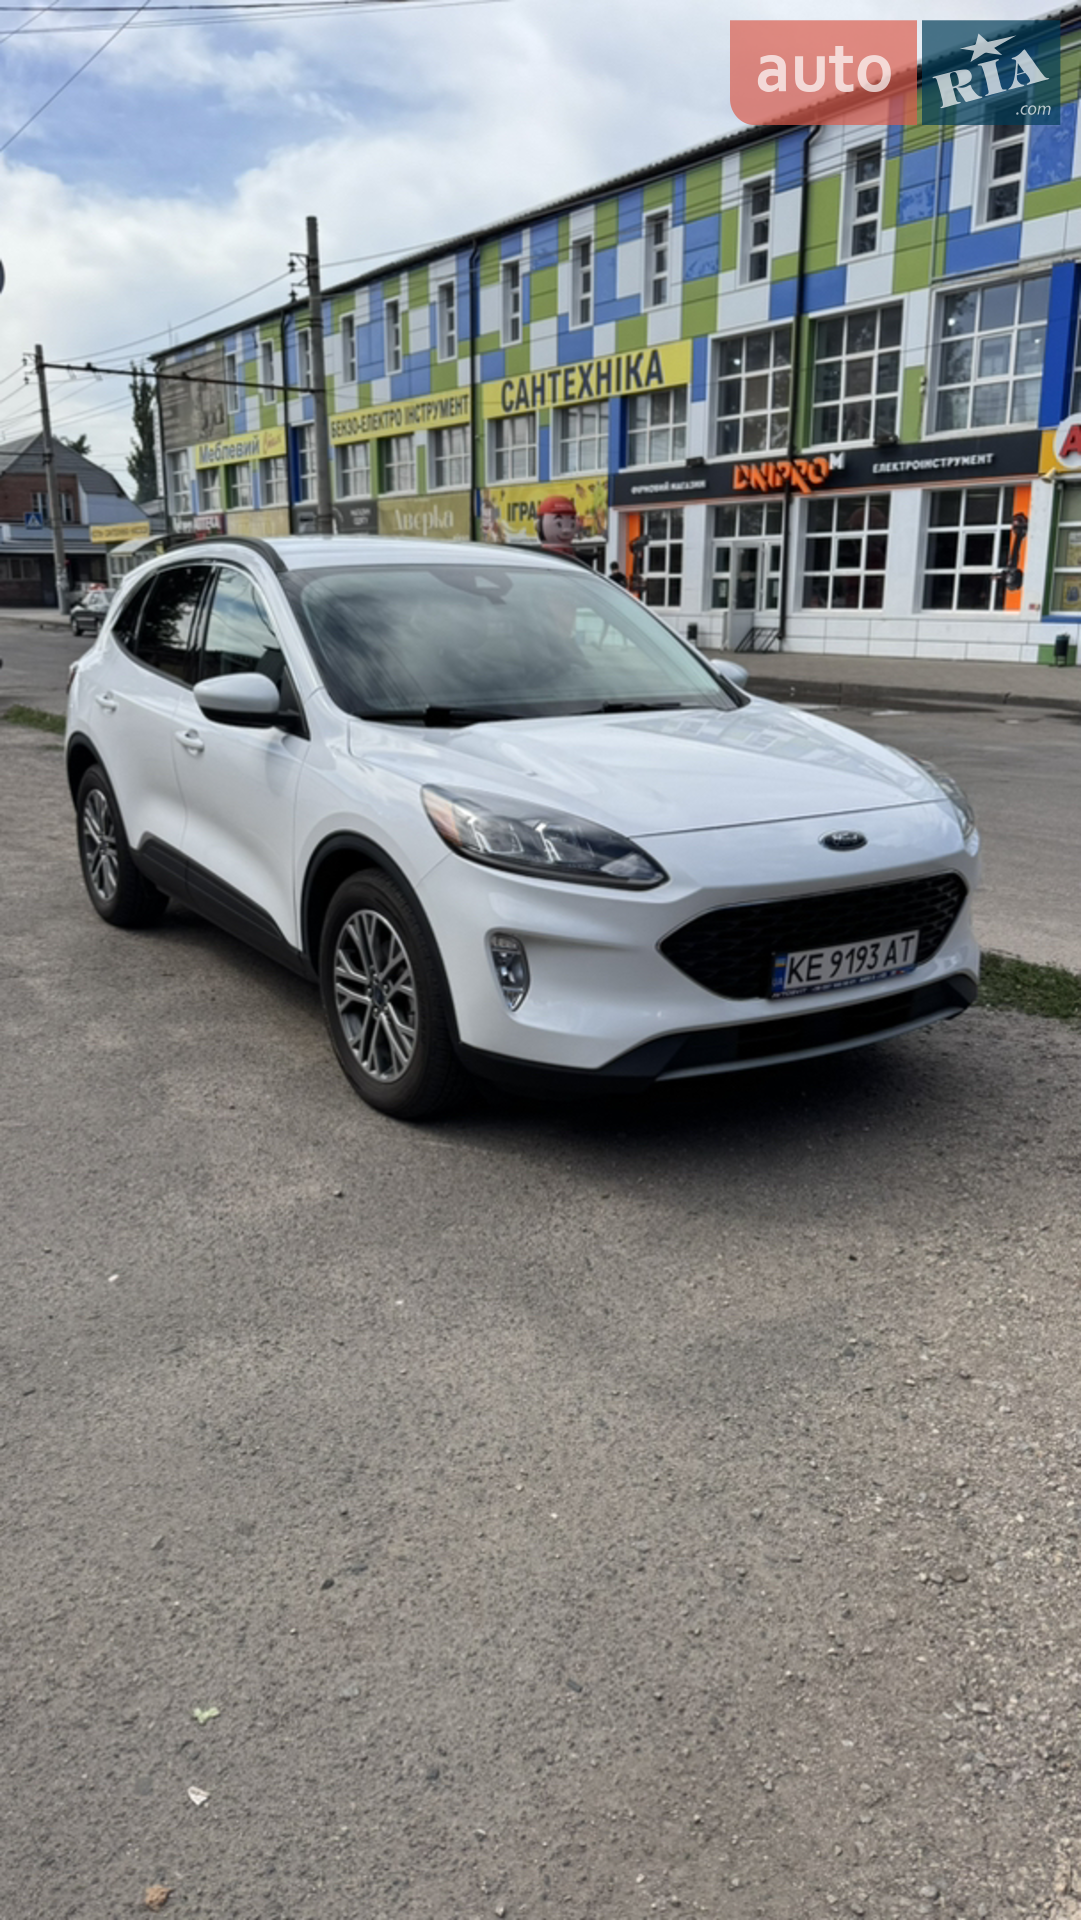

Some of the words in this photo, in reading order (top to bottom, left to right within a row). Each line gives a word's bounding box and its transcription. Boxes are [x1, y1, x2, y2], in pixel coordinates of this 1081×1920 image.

[501, 349, 664, 413] САНТЕХНІКА
[404, 394, 469, 425] ІНСТРУМЕНТ
[199, 435, 260, 464] Меблевий
[872, 453, 994, 474] ЕЛЕКТРОІНСТРУМЕНТ
[787, 953, 824, 985] KE
[829, 942, 881, 979] 9193
[883, 934, 916, 967] AT
